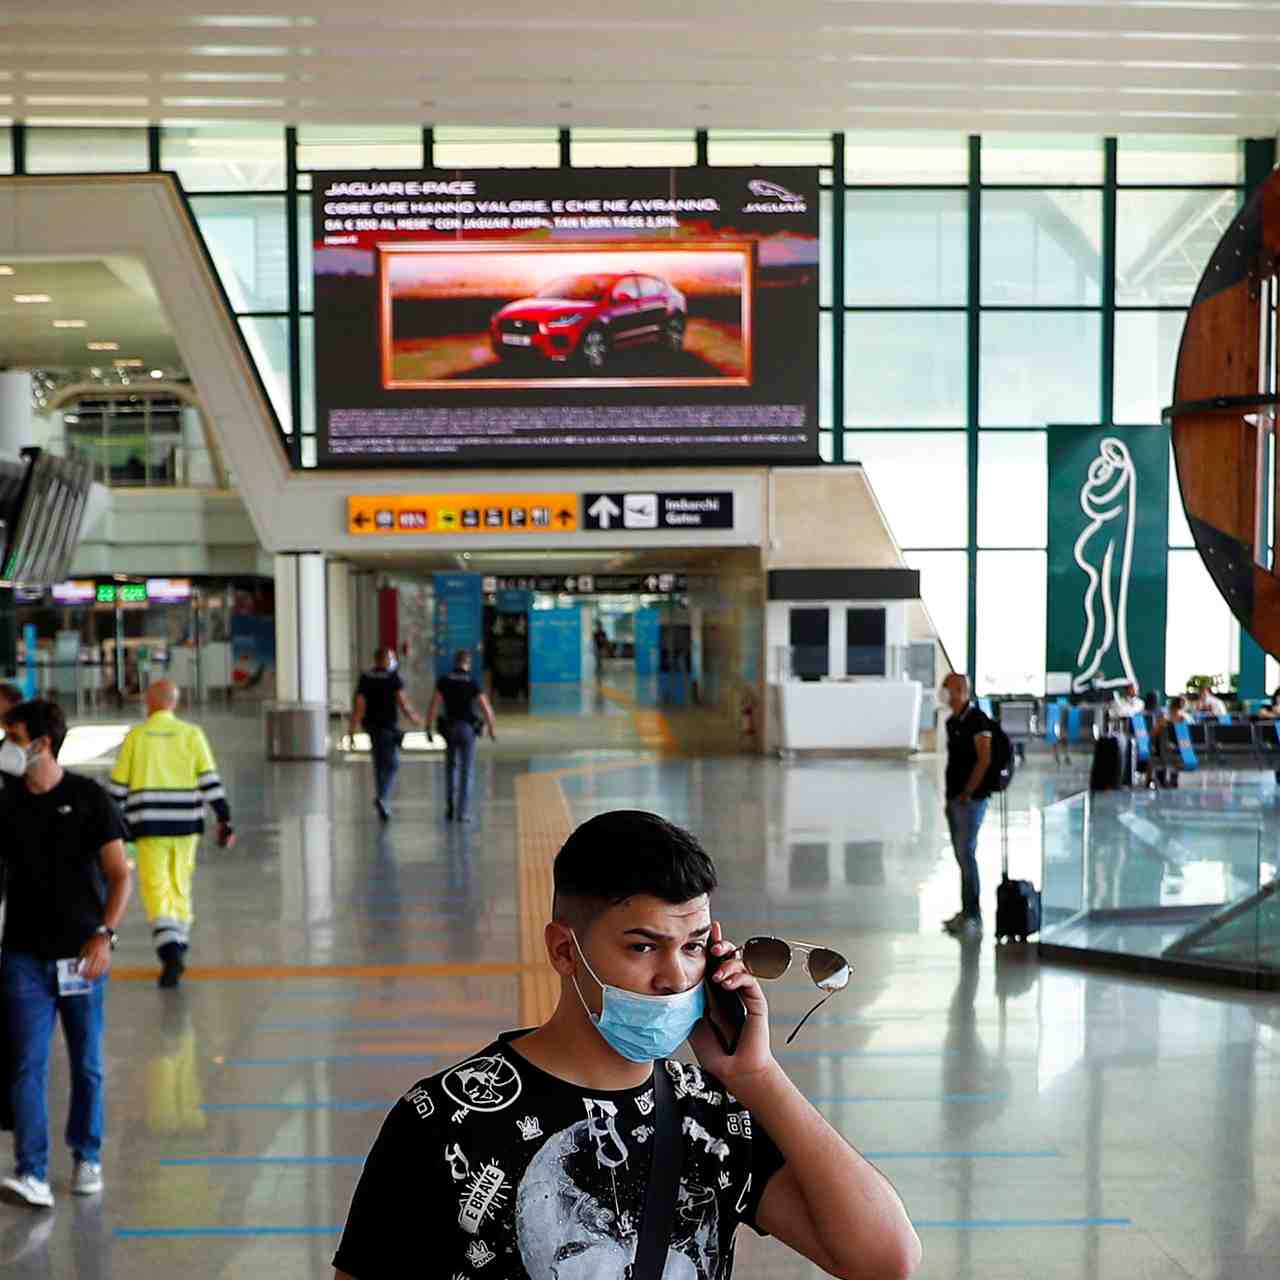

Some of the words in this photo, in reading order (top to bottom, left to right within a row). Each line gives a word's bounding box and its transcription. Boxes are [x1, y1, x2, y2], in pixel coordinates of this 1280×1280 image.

[324, 181, 404, 196] JAGUAR
[405, 181, 477, 195] E-PACE
[324, 202, 371, 215] COSE
[373, 202, 410, 214] CHE
[410, 201, 475, 213] HANNO
[552, 201, 564, 212] E
[565, 200, 602, 213] CHE
[603, 200, 629, 212] NE
[665, 497, 720, 512] Imbarchi
[665, 512, 702, 525] Gates
[470, 1167, 502, 1211] BRAVE
